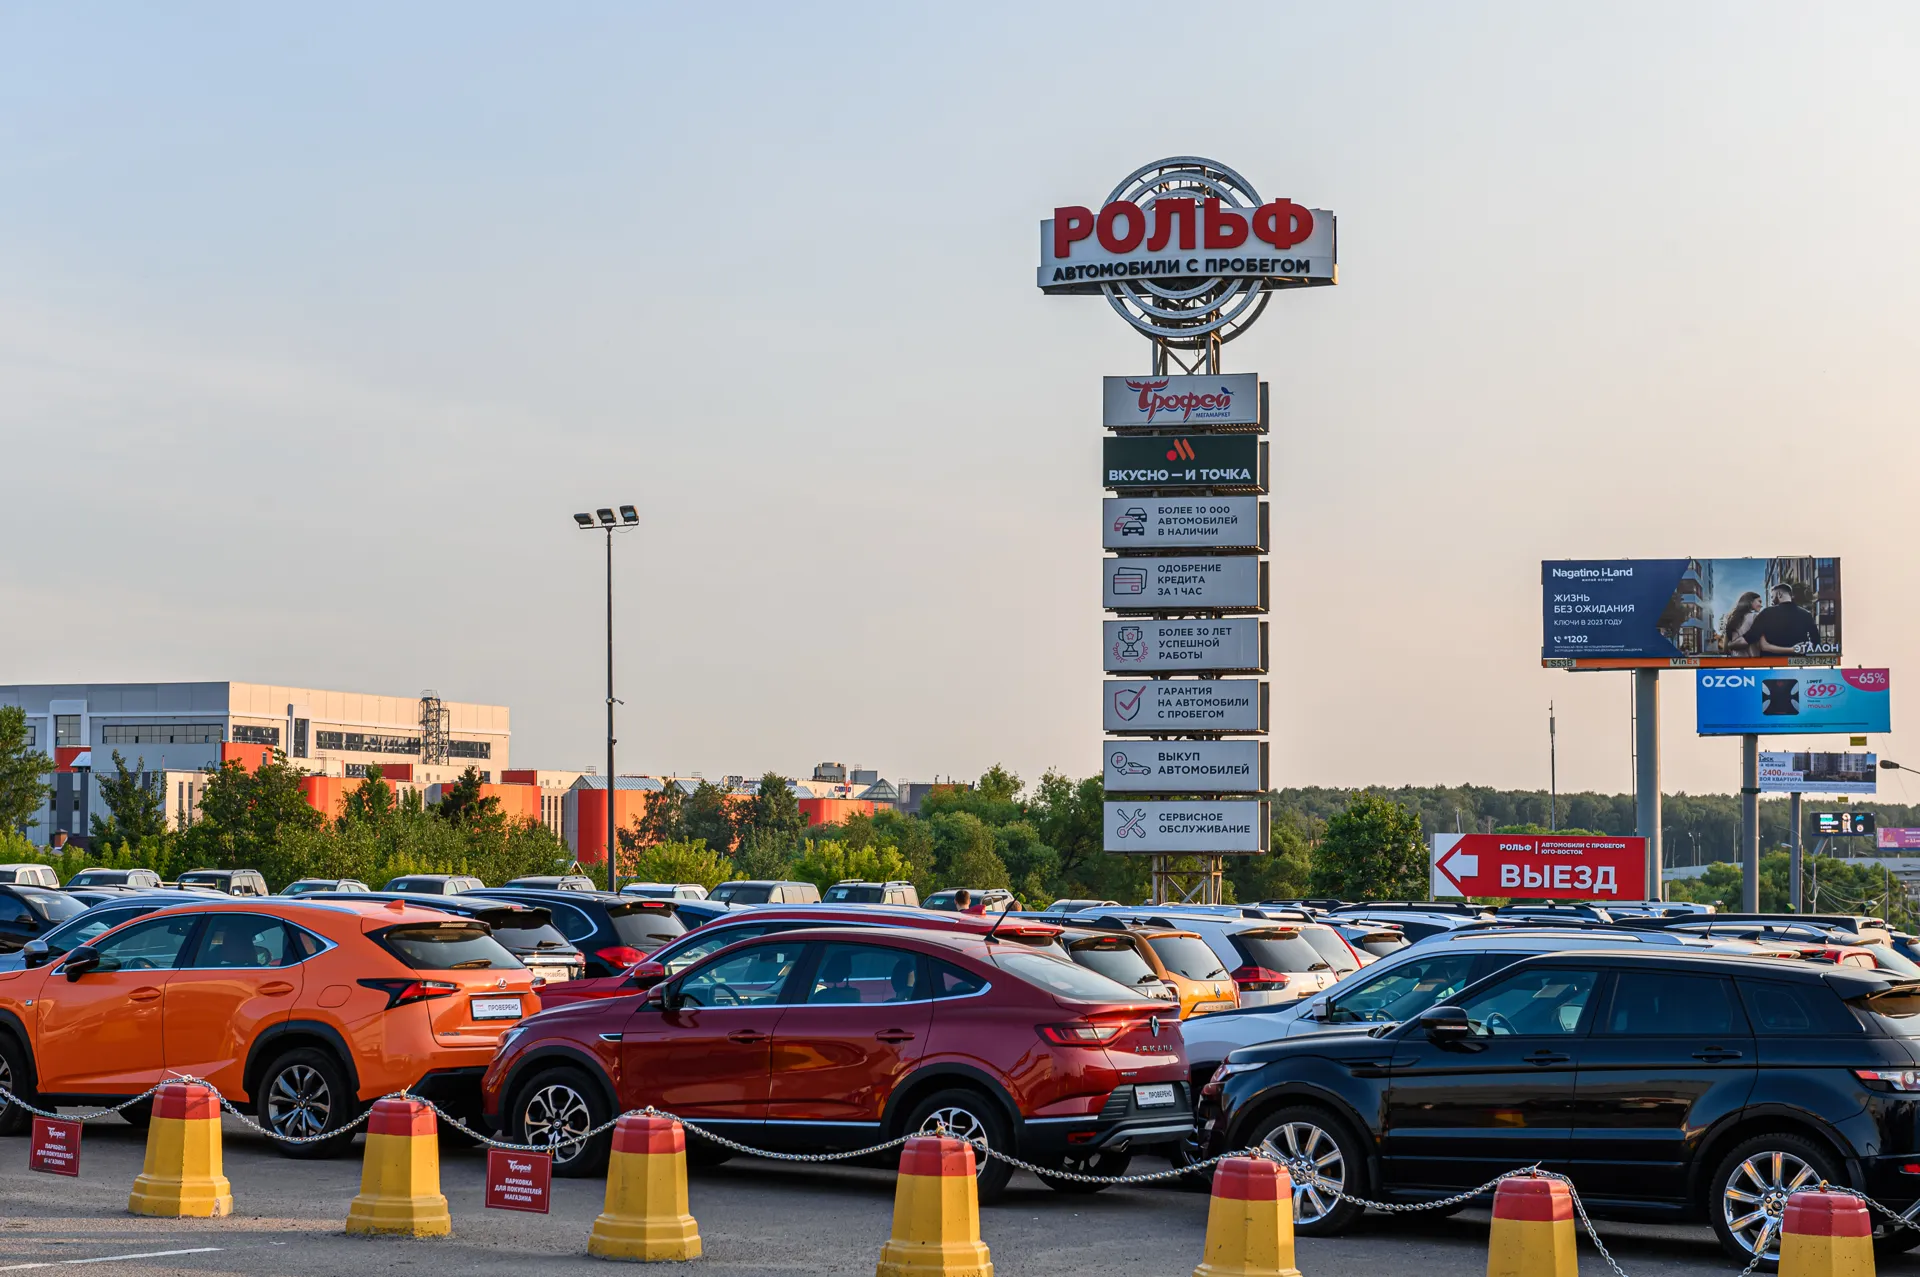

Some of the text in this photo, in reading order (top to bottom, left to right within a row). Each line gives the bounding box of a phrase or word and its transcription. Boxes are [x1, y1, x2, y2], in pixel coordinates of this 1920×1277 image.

[1054, 198, 1314, 258] РОЛЬФ
[1052, 258, 1310, 282] АВТОМОБИЛИ С ПРОБЕГОМ
[1125, 377, 1232, 424] Трофей
[1108, 469, 1169, 481] ВКУСНО
[1186, 469, 1196, 480] И
[1200, 468, 1251, 480] ТОЧКА
[1158, 506, 1192, 514] БОЛЕЕ
[1158, 515, 1238, 524] АВТОМОБИЛЕЙ
[1168, 528, 1218, 536] НАЛИЧИИ
[1158, 564, 1222, 573] ОДОБРЕНИЕ
[1552, 568, 1633, 579] Nagatino i-Land
[1158, 576, 1206, 584] КРЕДИТА
[1180, 588, 1202, 596] ЧАС
[1554, 594, 1590, 602] ЖИЗНЬ
[1575, 605, 1634, 614] ОЖИДАНИЯ
[1159, 628, 1232, 636] БОЛЕЕ 30 ЛЕТ
[1159, 638, 1220, 648] УСПЕШНОЙ
[1794, 643, 1839, 653] ЭТАЛОН
[1159, 652, 1202, 660] РАБОТЫ
[1702, 676, 1755, 688] OZON
[1158, 687, 1212, 695] ГАРАНТИЯ
[1807, 684, 1837, 696] 699
[1175, 698, 1248, 706] АВТОМОБИЛИ
[1168, 710, 1224, 718] ПРОБЕГОМ
[1158, 753, 1200, 761] ВЫКУП
[1158, 764, 1249, 774] АВТОМОБИЛЕЙ
[1159, 825, 1250, 833] ОБСЛУЖИВАНИЕ
[1501, 864, 1618, 894] ВЫЕЗД
[505, 1178, 532, 1186] ПАРКОВКА
[507, 1186, 542, 1195] ПОКУПАТЕЛЕЙ
